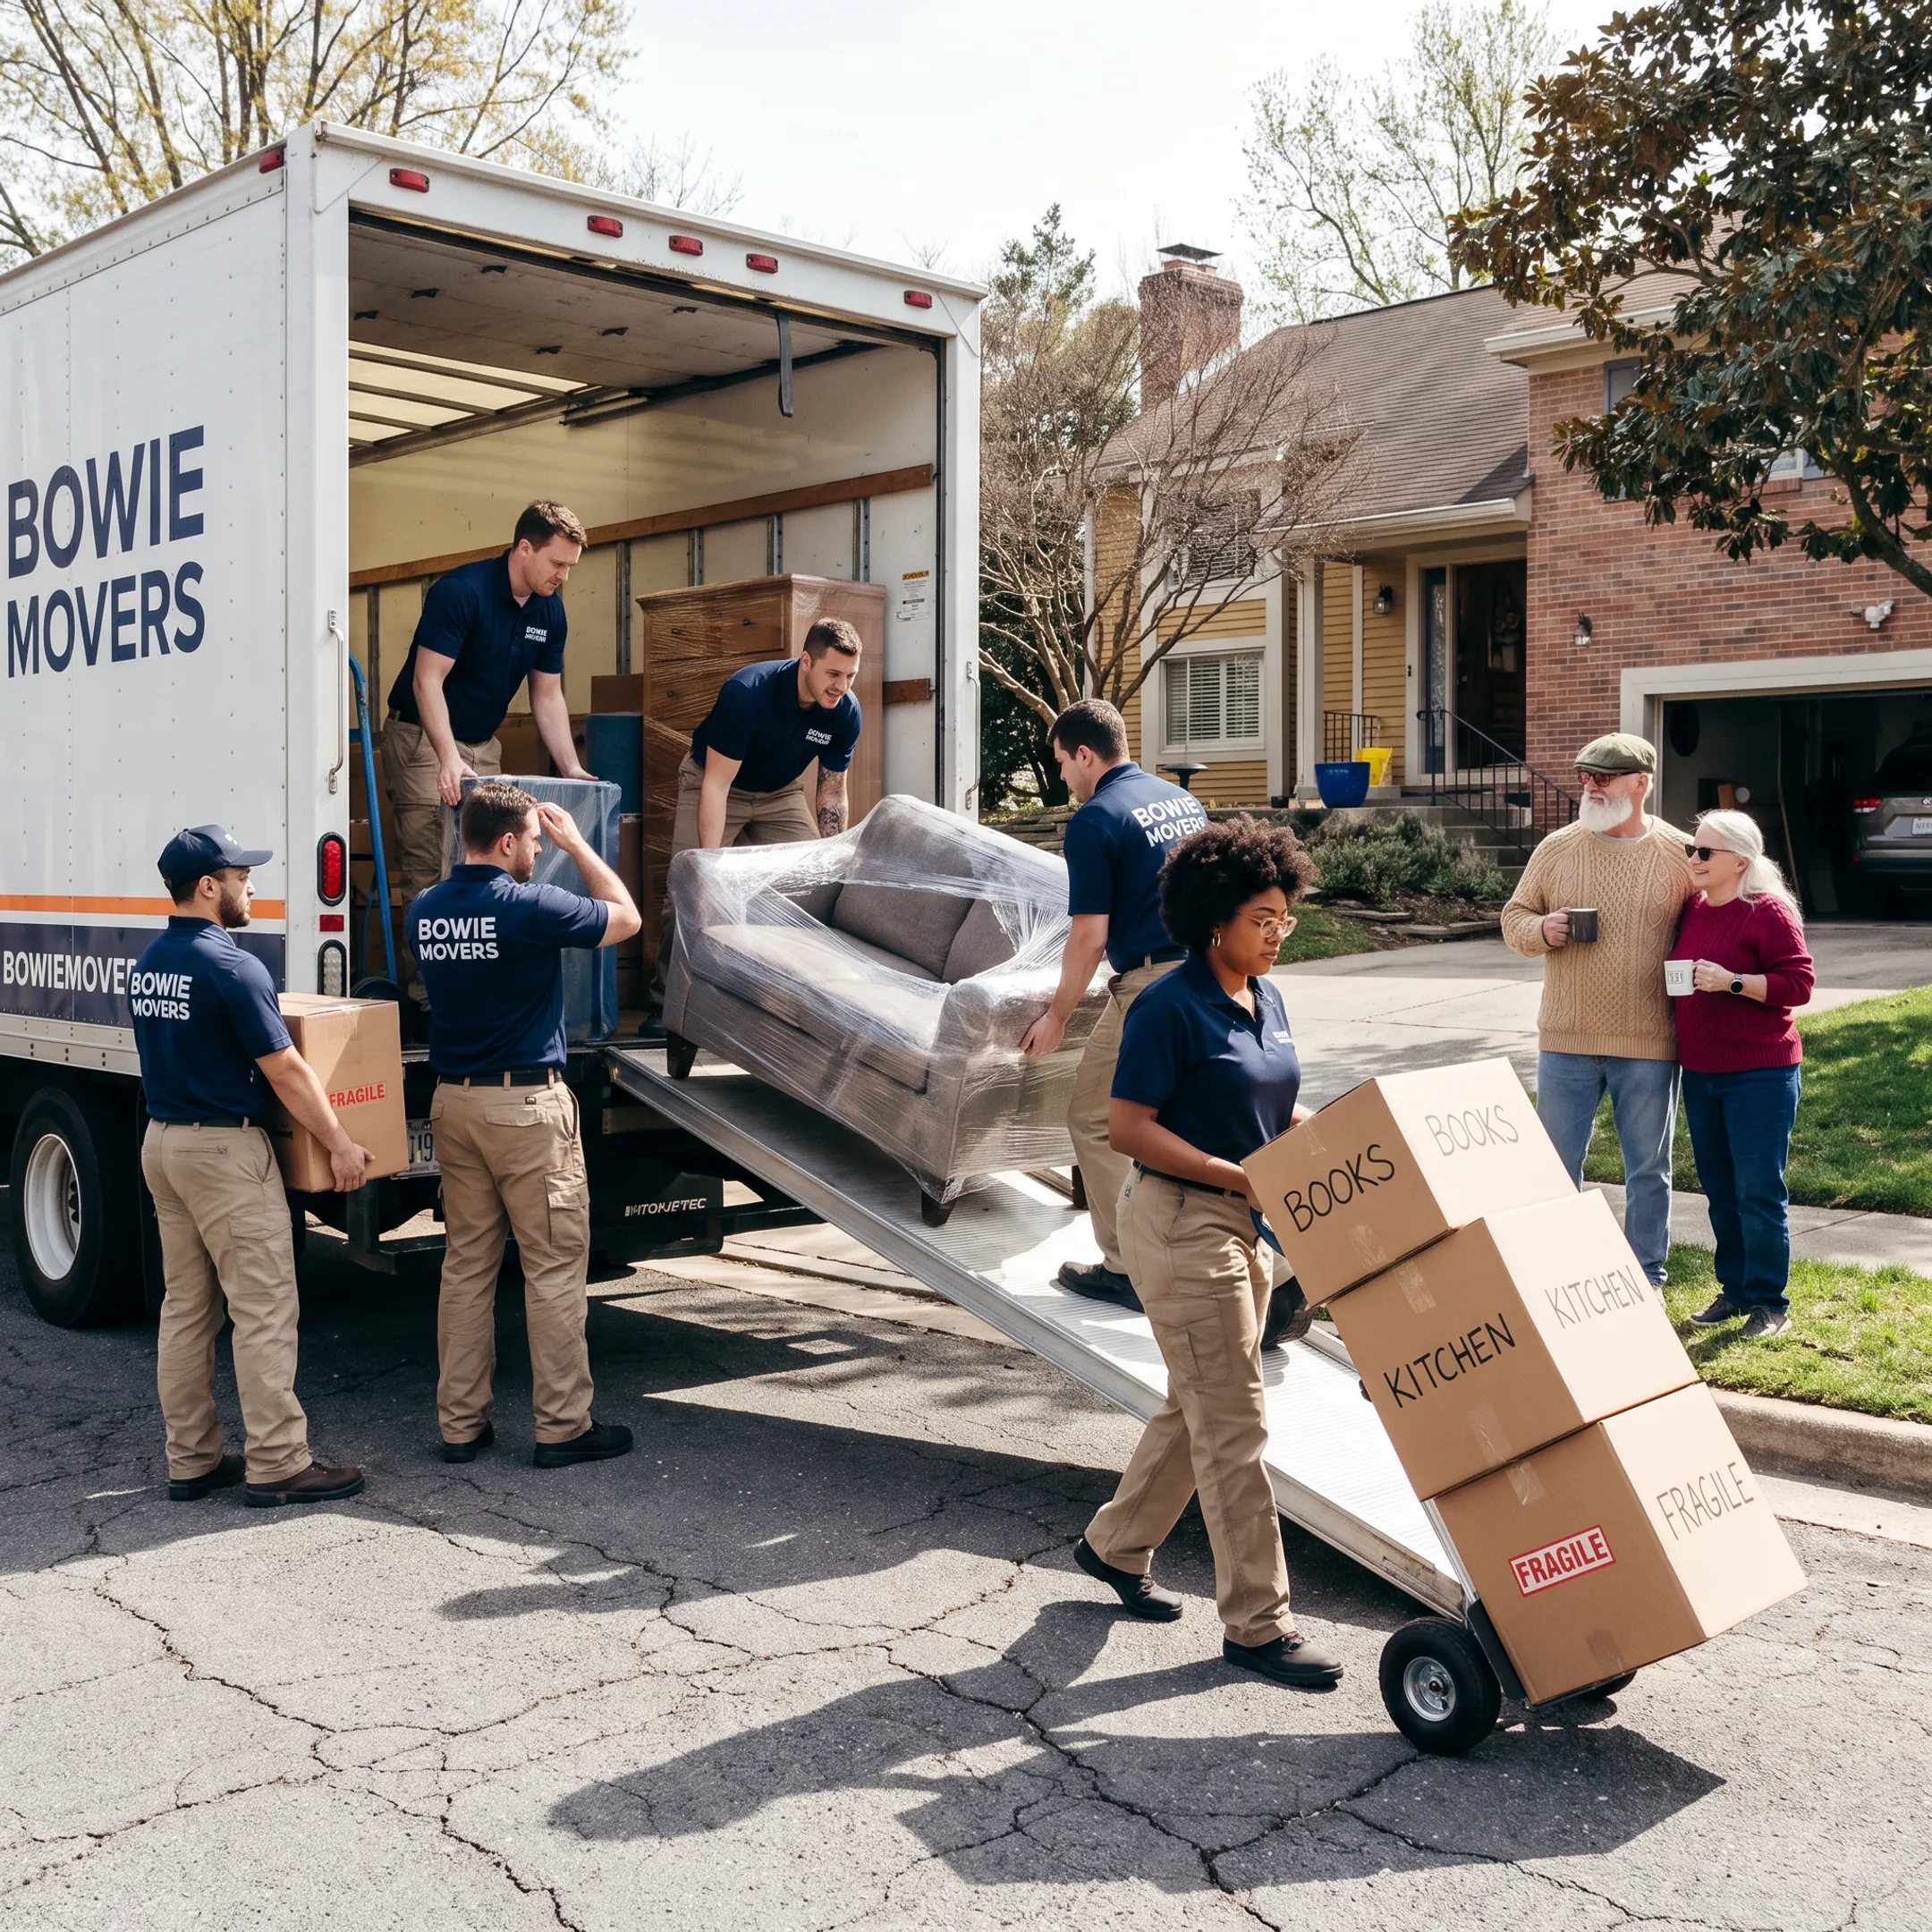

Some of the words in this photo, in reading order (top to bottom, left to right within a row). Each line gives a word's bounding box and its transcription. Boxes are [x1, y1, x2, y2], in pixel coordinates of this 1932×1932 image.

[8, 424, 204, 580] BOWIE
[7, 561, 205, 678] MOVERS
[1131, 796, 1200, 828] BOWIE
[418, 917, 496, 940] BOWIE
[419, 942, 499, 961] MOVERS
[131, 972, 192, 1000] BOWIE
[131, 998, 191, 1021] MOVERS
[328, 1084, 386, 1108] FRAGILE
[1425, 1104, 1519, 1157] BOOKS
[1284, 1143, 1395, 1233] BOOKS
[1545, 1265, 1645, 1329] KITCHEN
[1383, 1312, 1516, 1409] KITCHEN
[1657, 1462, 1755, 1541] FRAGILE
[1515, 1532, 1608, 1589] FRAGILE
